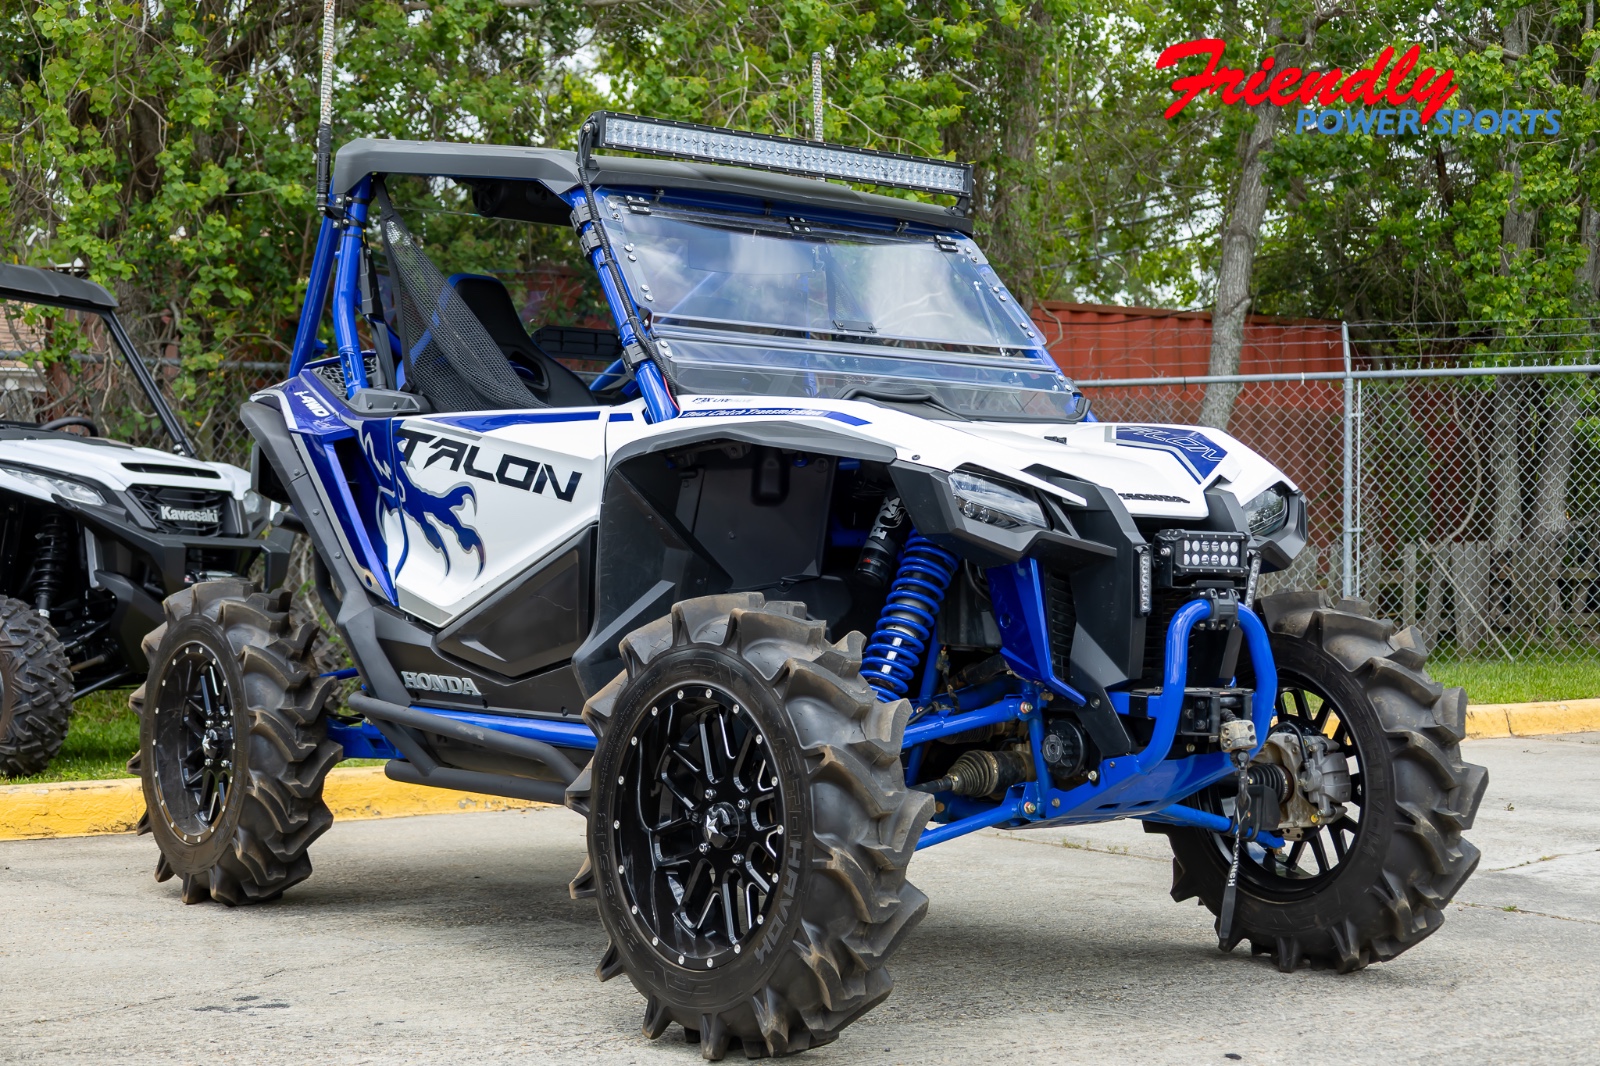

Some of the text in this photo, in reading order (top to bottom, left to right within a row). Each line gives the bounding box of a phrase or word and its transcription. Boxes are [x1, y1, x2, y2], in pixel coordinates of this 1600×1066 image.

[394, 427, 583, 503] TALON
[1117, 492, 1191, 504] HONDA
[160, 505, 219, 523] Kawasaki
[869, 496, 902, 541] FOX
[400, 670, 482, 697] HONDA
